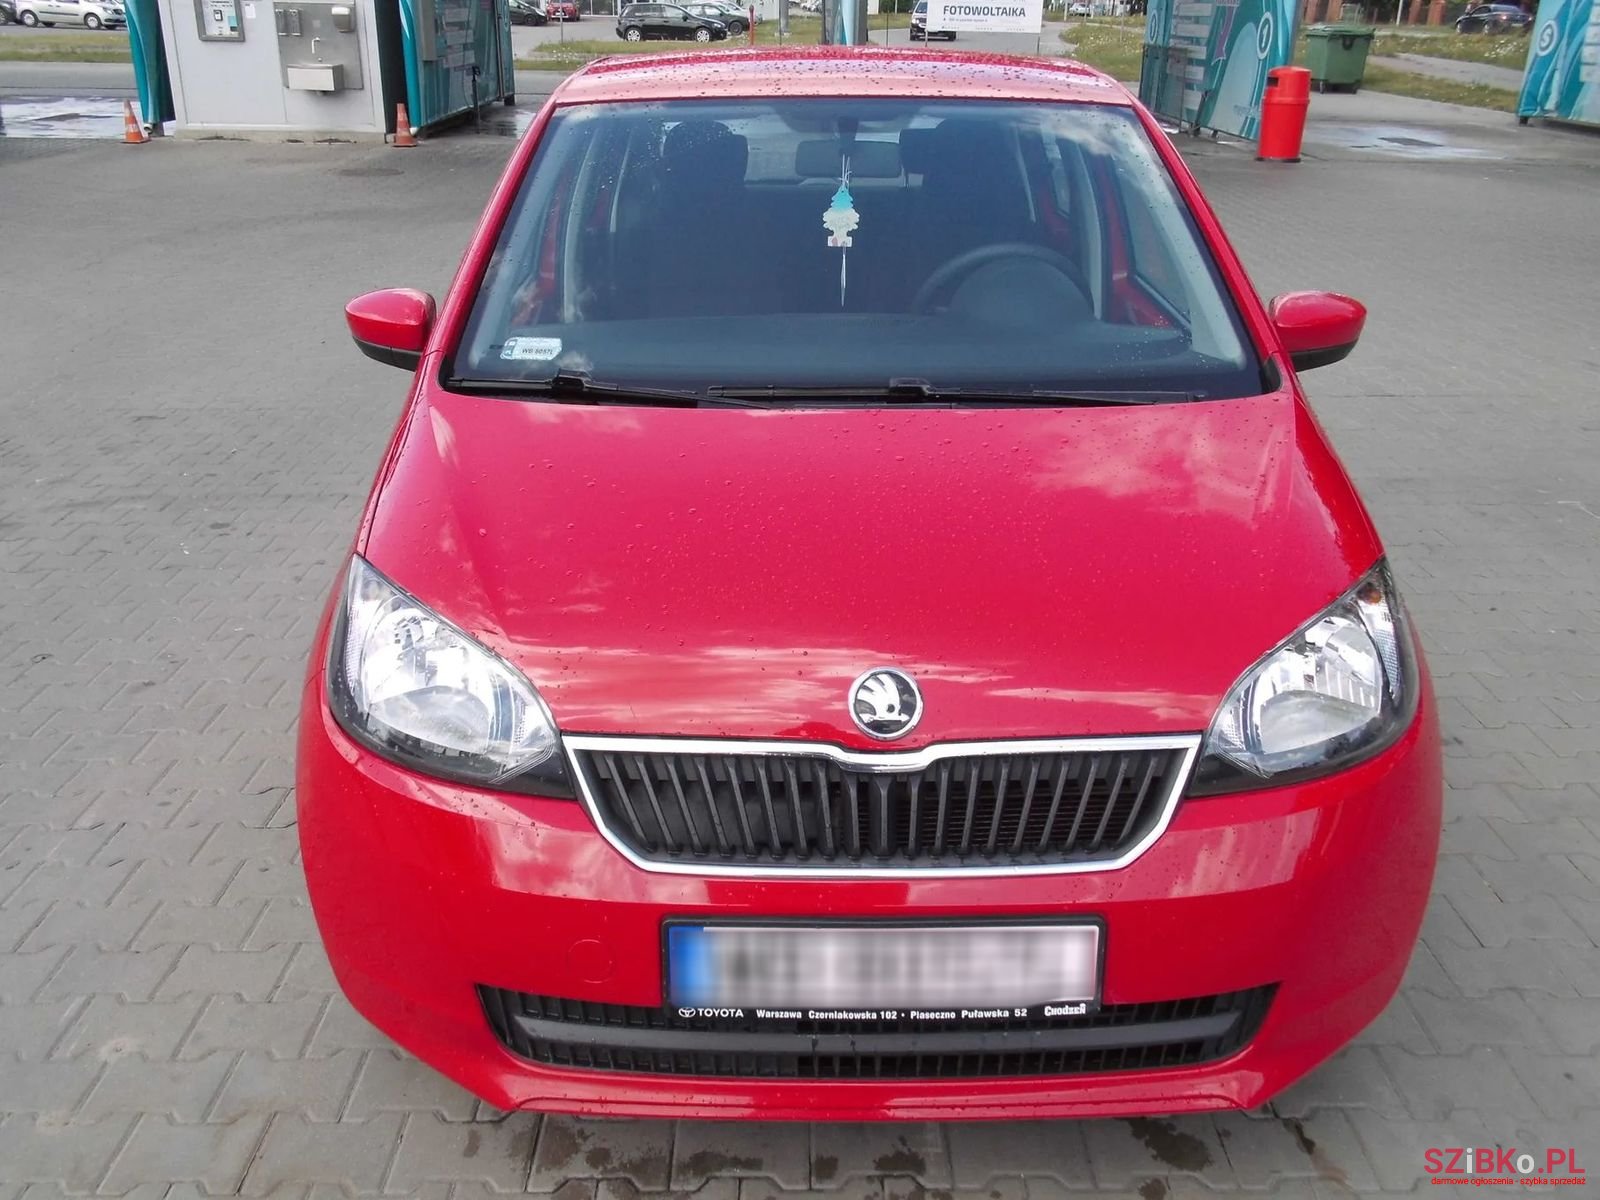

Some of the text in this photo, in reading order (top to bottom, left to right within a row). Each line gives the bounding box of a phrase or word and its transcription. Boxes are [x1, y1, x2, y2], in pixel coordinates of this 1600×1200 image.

[943, 5, 1026, 17] FOTOWOLTAIKA
[697, 1008, 744, 1018] TOYOTA
[756, 1009, 803, 1019] Warszawa
[808, 1010, 877, 1020] Czerniakowska
[880, 1010, 898, 1020] 102
[910, 1010, 956, 1020] Piaseczno
[961, 1008, 1010, 1019] Puławska
[1014, 1008, 1028, 1018] 52
